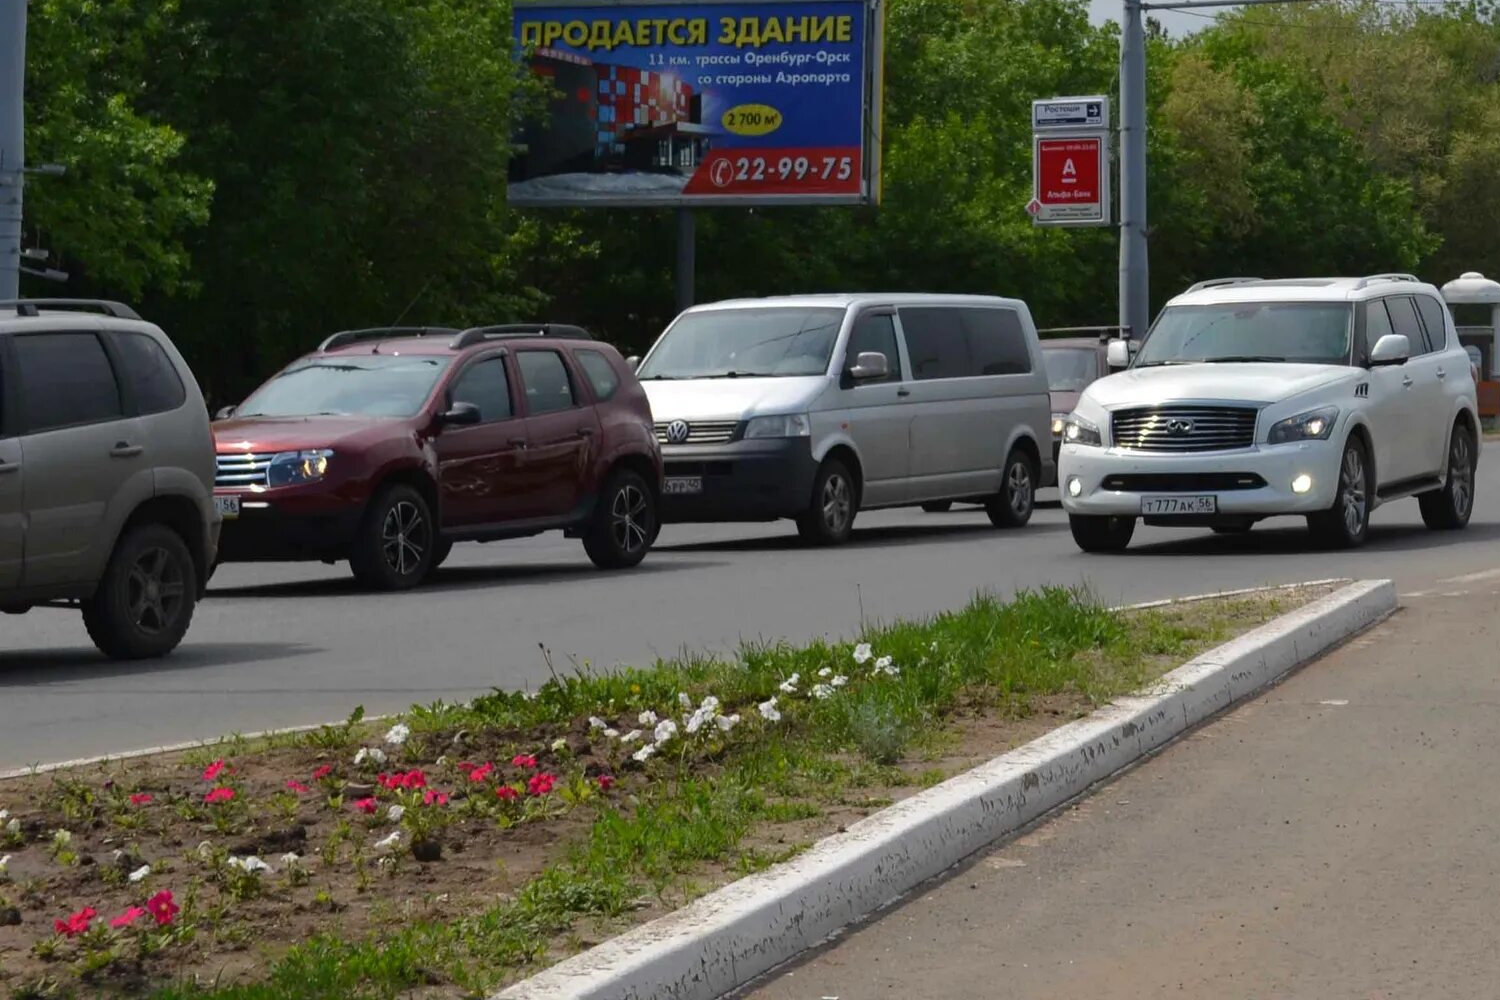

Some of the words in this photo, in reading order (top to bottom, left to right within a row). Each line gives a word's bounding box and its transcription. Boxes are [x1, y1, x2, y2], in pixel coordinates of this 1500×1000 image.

[520, 17, 707, 50] ПРОДАЕТСЯ
[717, 15, 852, 48] ЗДАНИЕ
[649, 53, 664, 66] 11
[669, 55, 691, 65] км.
[696, 53, 741, 67] трассы
[744, 49, 851, 67] Оренбург-Орск
[697, 74, 712, 84] со
[715, 73, 772, 87] стороны
[775, 71, 851, 87] Аэропорта
[727, 113, 736, 126] 2
[739, 112, 762, 126] 700
[735, 156, 852, 181] 22-99-75
[223, 499, 236, 510] 56
[1147, 499, 1194, 512] Т777АК
[1198, 497, 1212, 508] 56
